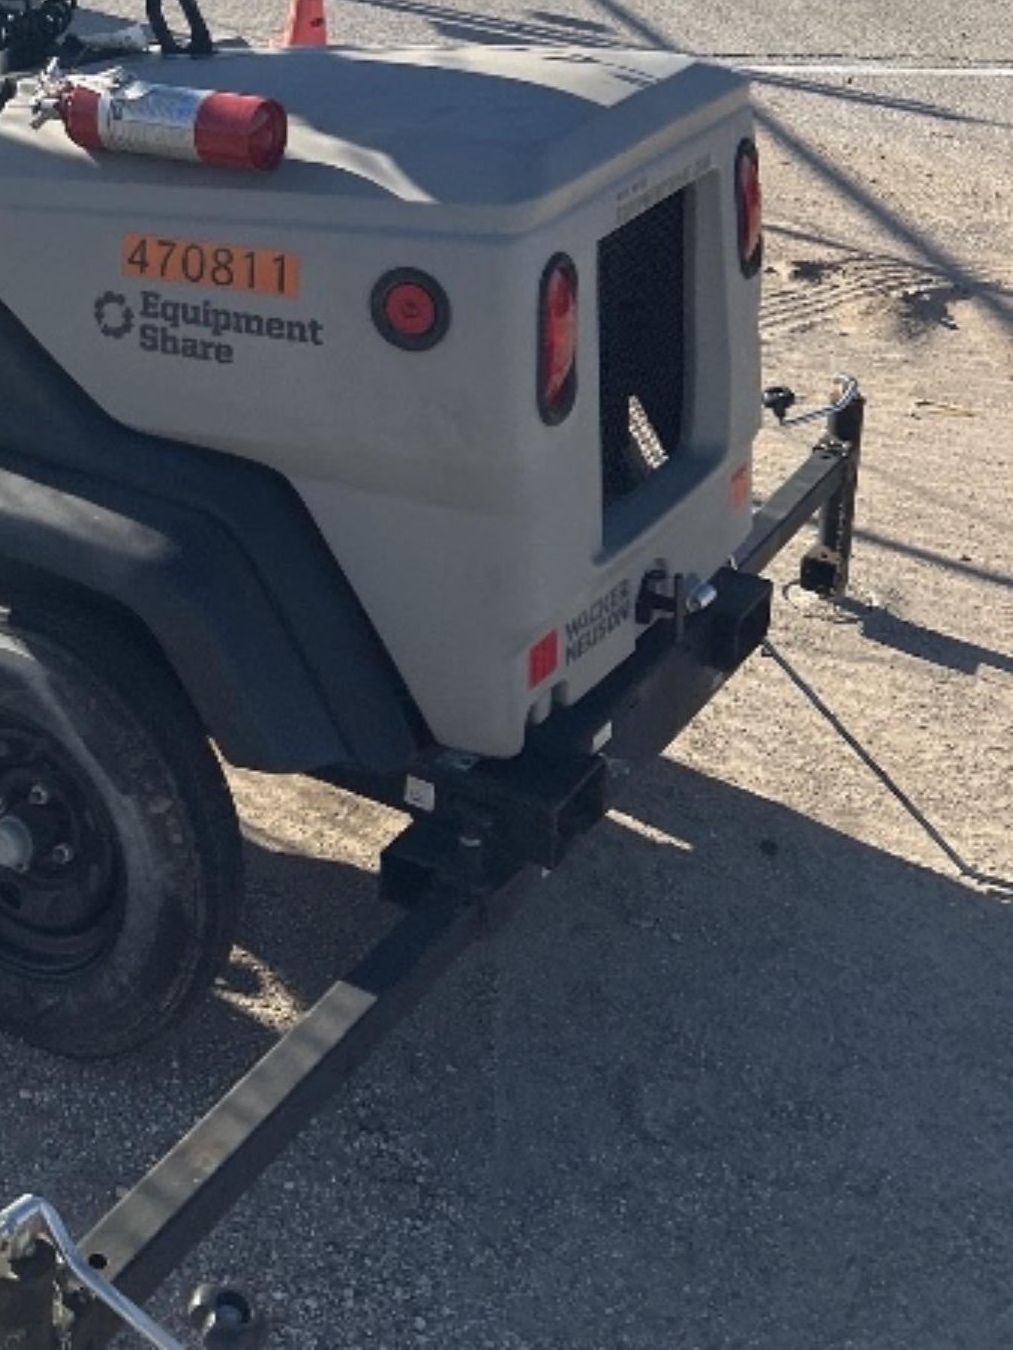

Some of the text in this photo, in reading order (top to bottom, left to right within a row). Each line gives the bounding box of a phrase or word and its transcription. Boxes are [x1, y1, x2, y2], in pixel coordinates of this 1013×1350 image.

[127, 237, 288, 294] 470811
[139, 290, 325, 346] Equipment
[139, 323, 235, 364] Share
